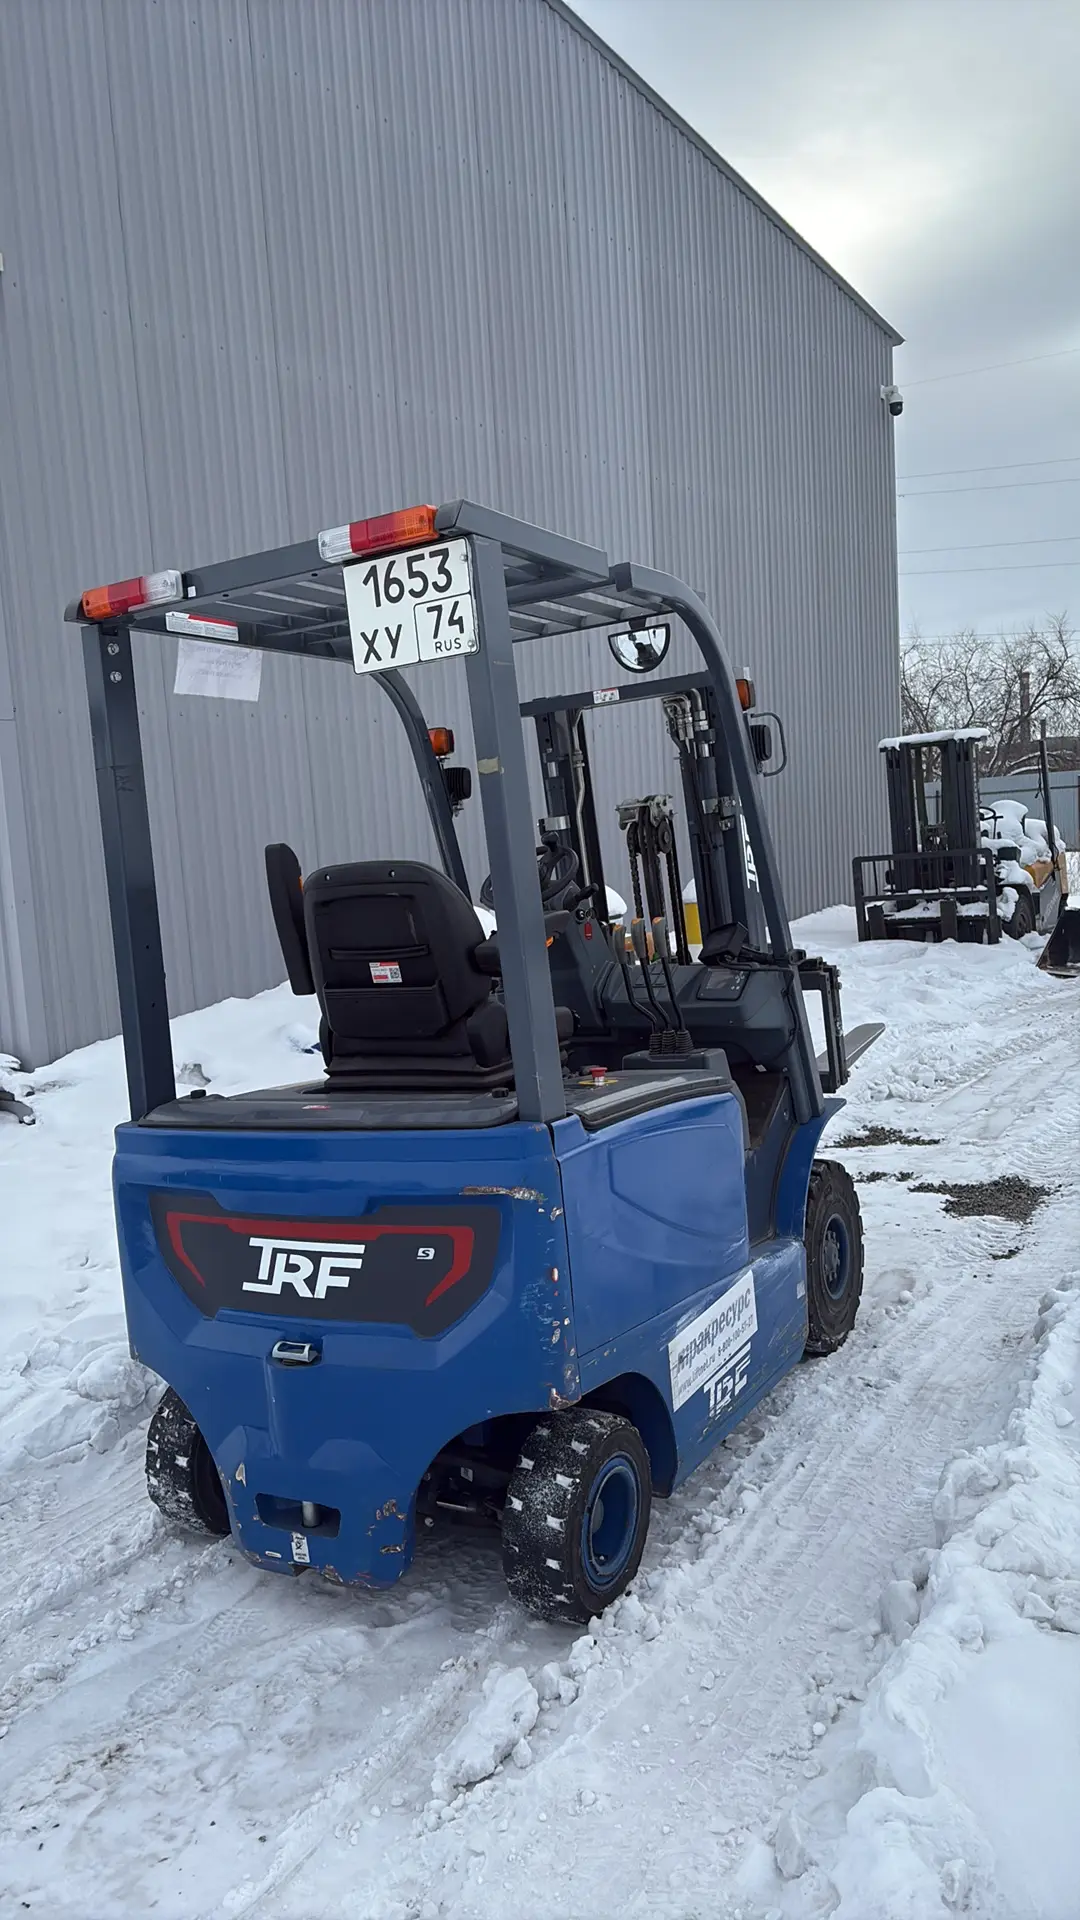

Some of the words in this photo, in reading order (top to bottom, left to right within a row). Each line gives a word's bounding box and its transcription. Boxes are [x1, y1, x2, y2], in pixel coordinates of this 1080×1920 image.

[362, 547, 453, 608] 1653
[426, 600, 465, 640] 74
[360, 623, 403, 664] ХУ
[434, 637, 462, 653] RUS
[242, 1237, 366, 1300] TRF
